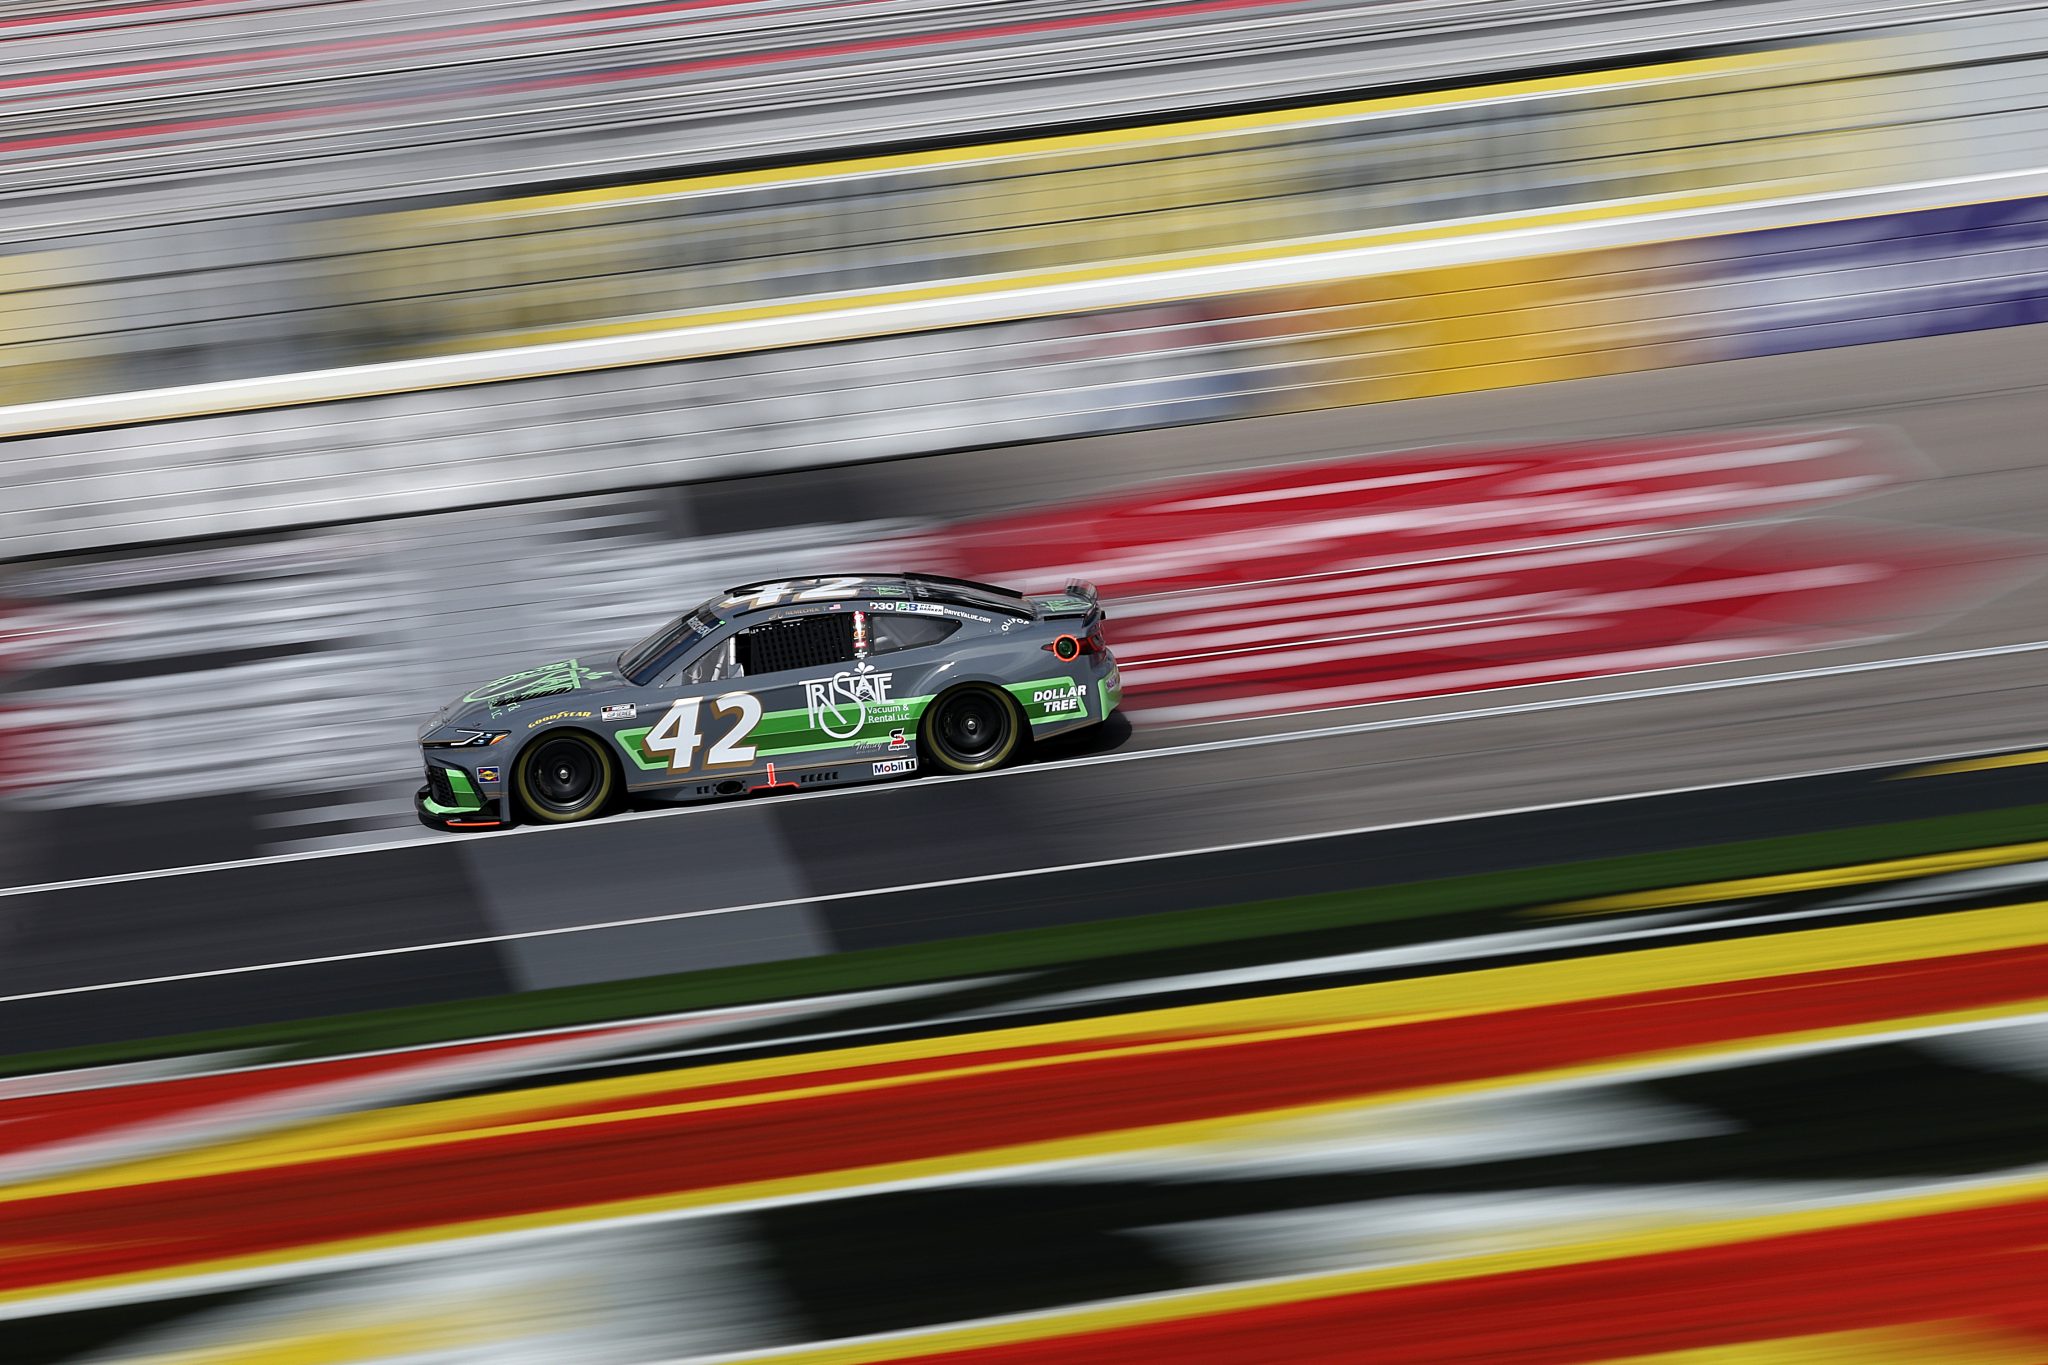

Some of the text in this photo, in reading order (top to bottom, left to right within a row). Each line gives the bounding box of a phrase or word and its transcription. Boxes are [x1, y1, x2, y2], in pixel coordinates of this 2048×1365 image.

[1001, 618, 1030, 632] OLIPOP
[1033, 684, 1087, 702] DOLLAR
[866, 706, 901, 714] Vacuum
[1043, 699, 1078, 712] TREE
[527, 711, 592, 728] GOODYEAR
[868, 713, 896, 723] Rental
[643, 691, 762, 771] 42
[874, 761, 904, 774] Mobil
